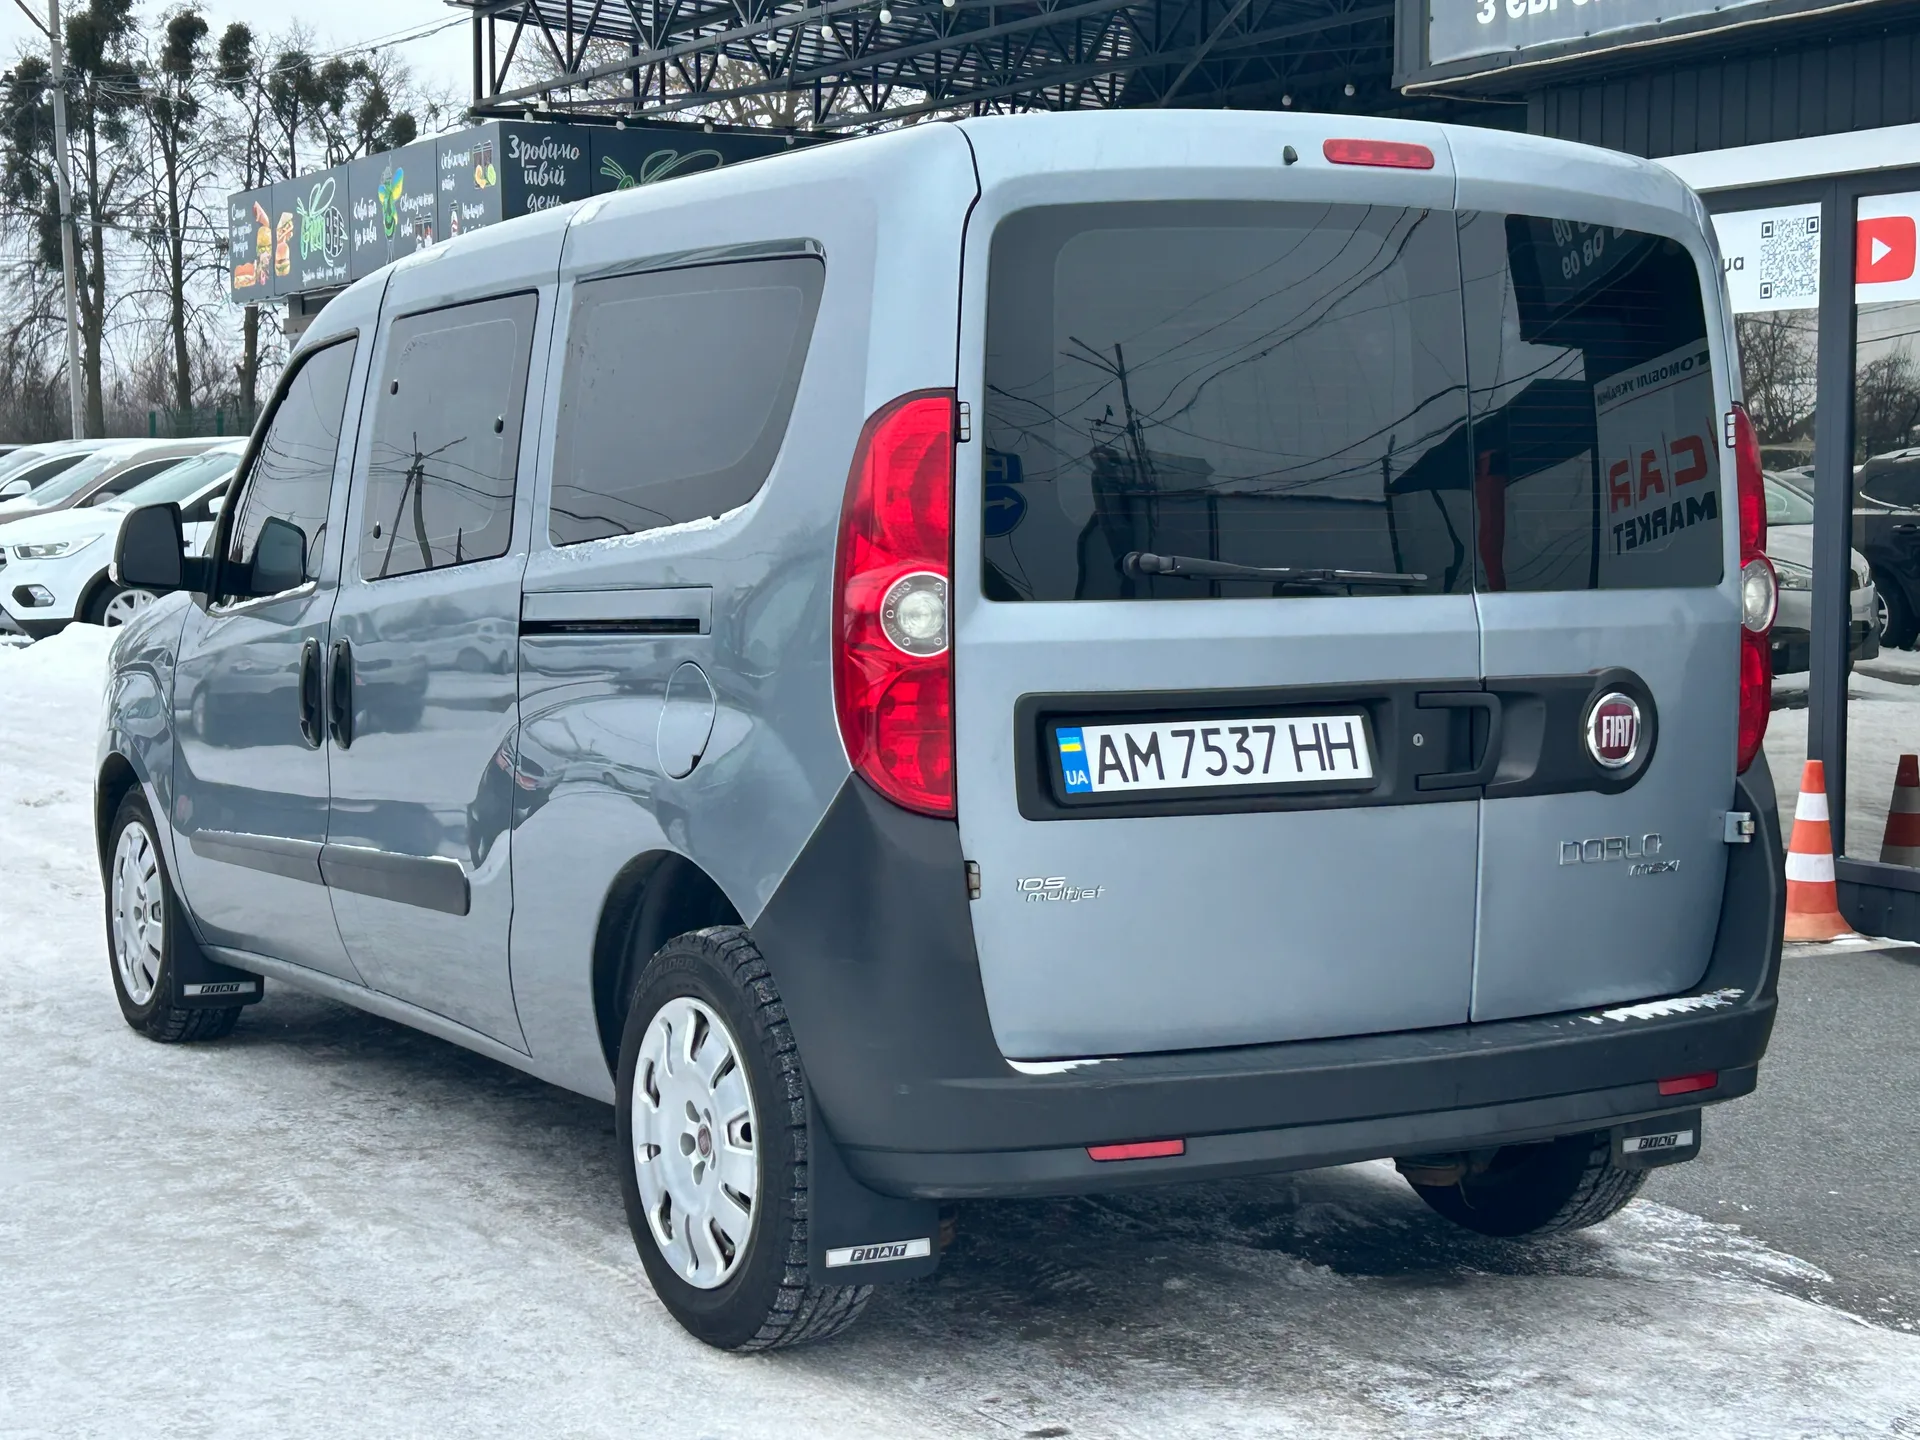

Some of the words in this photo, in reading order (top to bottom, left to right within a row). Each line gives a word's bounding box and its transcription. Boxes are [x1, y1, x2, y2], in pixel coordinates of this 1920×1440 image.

[509, 134, 580, 168] Зробимо
[524, 163, 566, 187] твій
[1602, 715, 1633, 748] FIAT
[1097, 731, 1165, 785] AM
[1170, 725, 1276, 779] 7537
[1288, 721, 1359, 772] HH
[1066, 770, 1089, 786] UA
[1016, 876, 1067, 892] 105
[1026, 885, 1106, 903] multijet
[200, 983, 241, 994] FIAT
[1639, 1134, 1678, 1149] FIAT
[850, 1244, 908, 1262] FIAT
